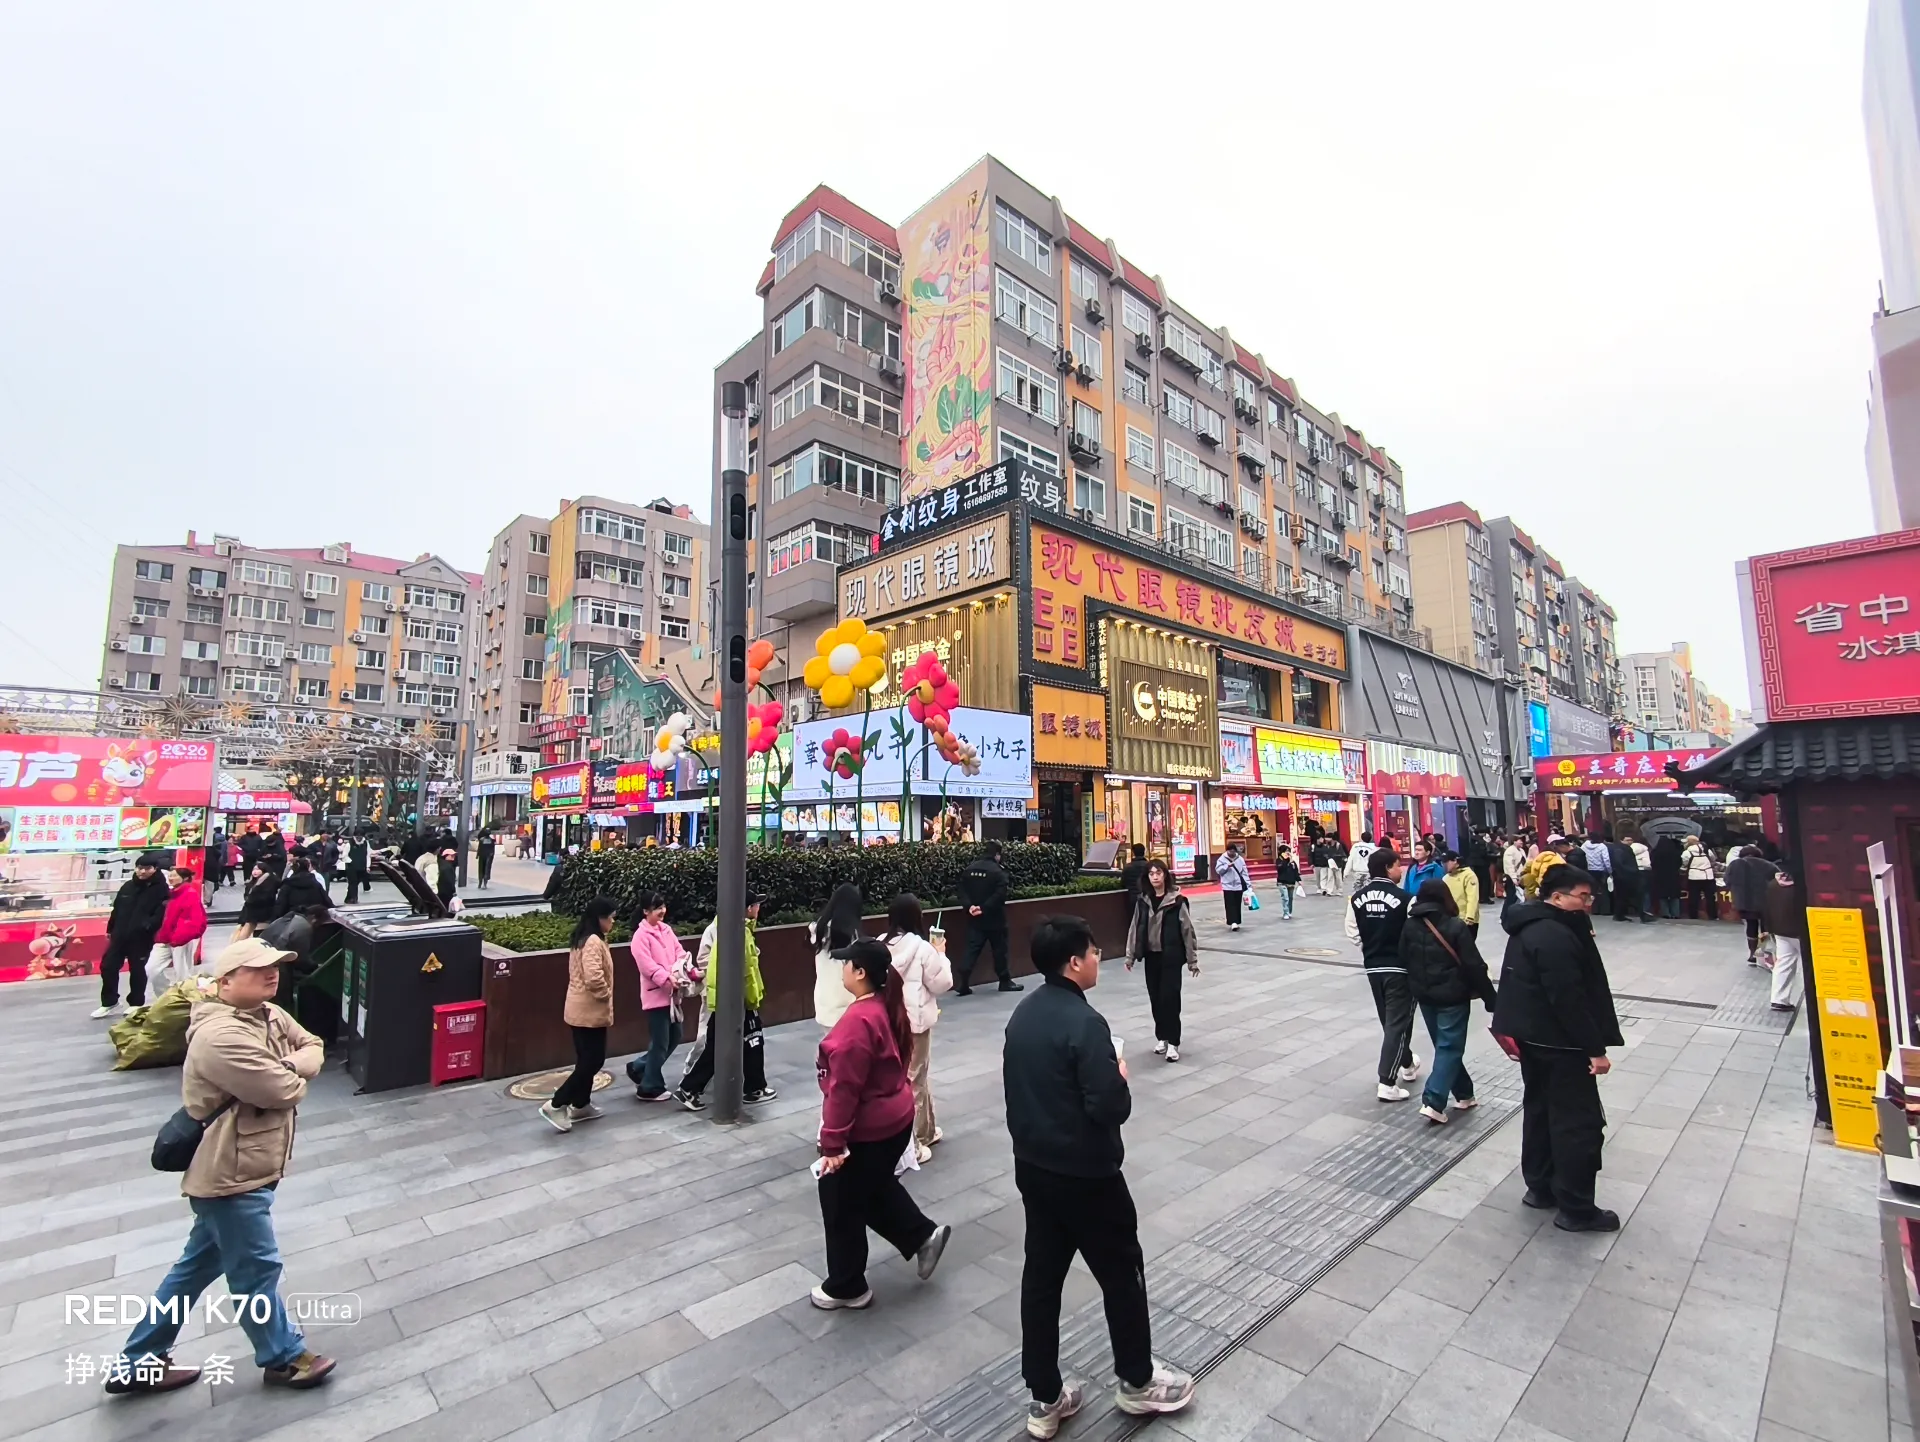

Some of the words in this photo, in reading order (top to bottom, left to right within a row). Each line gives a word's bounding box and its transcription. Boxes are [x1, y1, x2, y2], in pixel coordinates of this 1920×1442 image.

[964, 466, 1007, 499] 工作室
[1020, 470, 1062, 513] 纹身
[845, 526, 996, 617] 现代眼镜城
[1041, 533, 1298, 653] 现代眼镜批发城
[1794, 592, 1909, 634] 省中
[1157, 687, 1198, 712] 中国黄金
[1039, 712, 1104, 741] 眼镜城
[1160, 708, 1180, 721] China
[1179, 711, 1196, 723] Gold
[160, 743, 208, 757] 2026
[817, 788, 847, 799] 章鱼丸子
[19, 813, 116, 827] 生活就像糖葫芦
[1353, 890, 1402, 909] HANYANG
